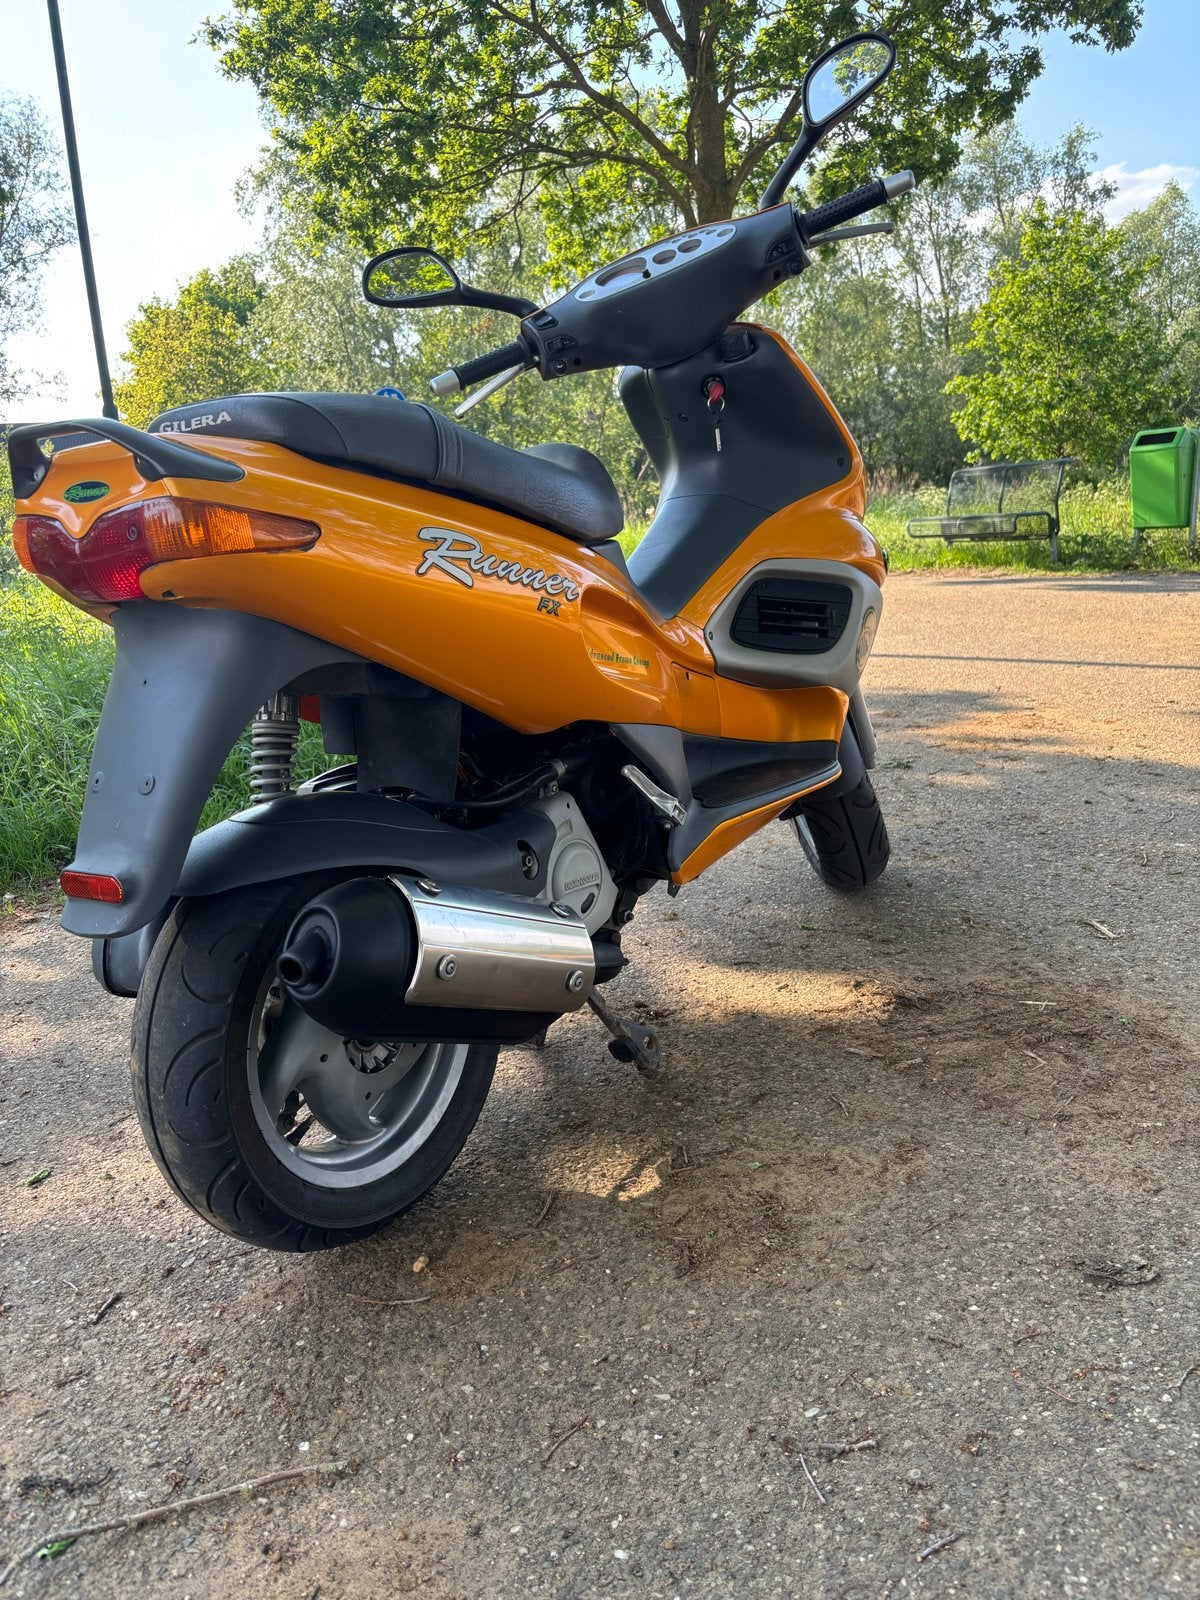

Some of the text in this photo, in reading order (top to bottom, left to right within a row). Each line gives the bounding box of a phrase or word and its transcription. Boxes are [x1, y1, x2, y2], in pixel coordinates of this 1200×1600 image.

[159, 411, 232, 433] GILERA
[416, 526, 580, 601] Runner
[537, 596, 561, 616] FX
